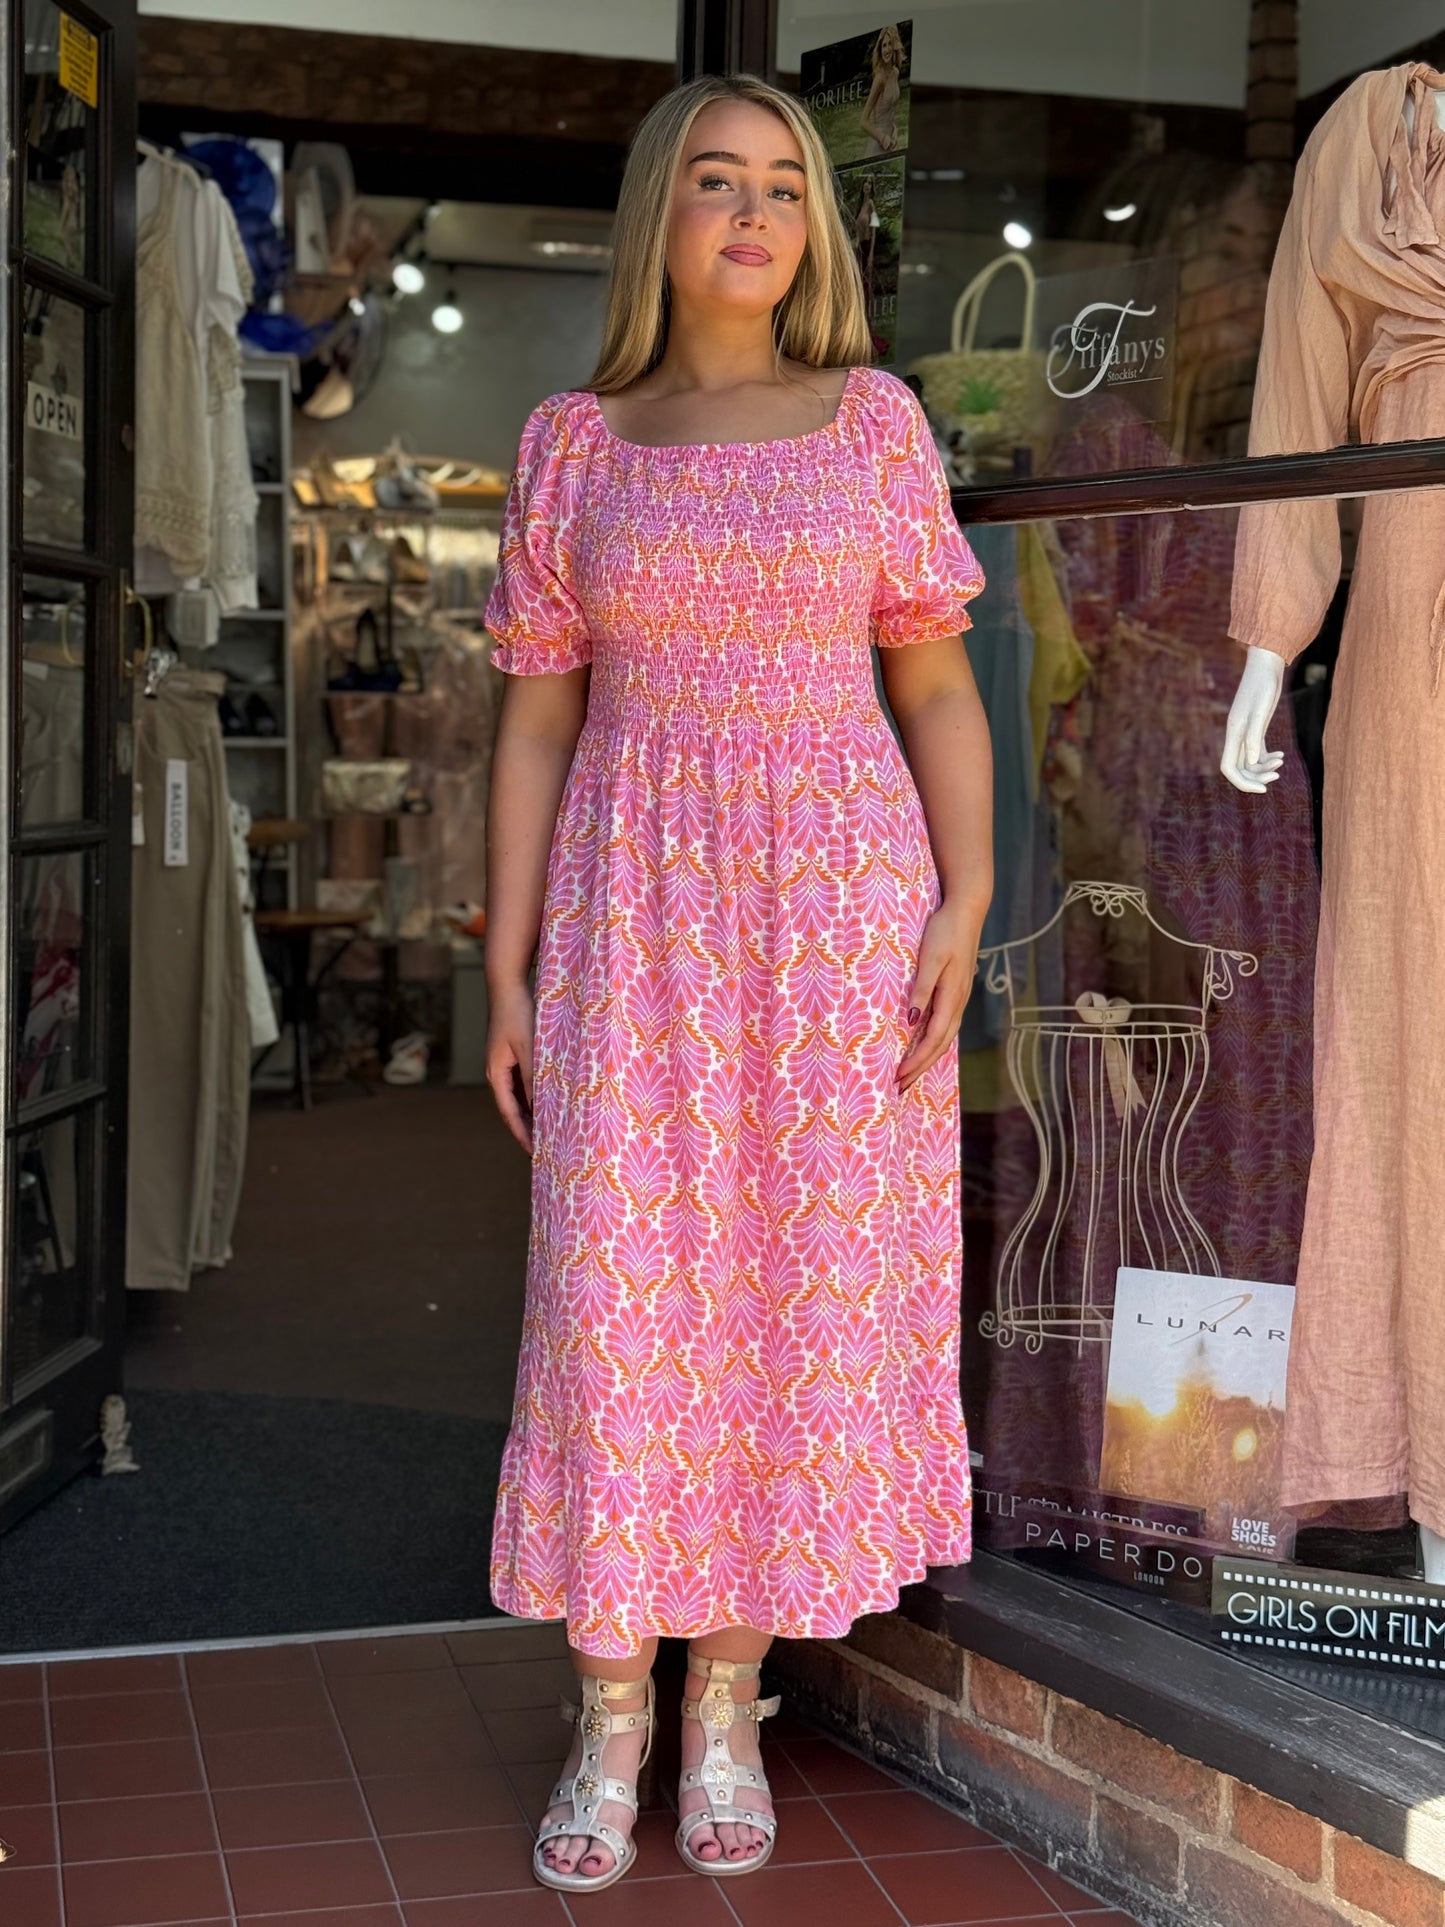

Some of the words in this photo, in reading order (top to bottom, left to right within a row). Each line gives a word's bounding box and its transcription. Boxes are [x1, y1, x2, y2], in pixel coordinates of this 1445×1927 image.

[803, 80, 863, 112] MORILEE
[1107, 368, 1137, 382] Stockist
[33, 392, 77, 437] OPEN
[1137, 1313, 1286, 1341] LUNAR
[1231, 1529, 1276, 1547] SHOES
[1232, 1517, 1269, 1534] LOVE
[1026, 1522, 1141, 1566] PAPER
[1133, 1570, 1166, 1587] LONDON
[1227, 1592, 1317, 1633] GIRLS
[1325, 1605, 1377, 1641] ON
[1386, 1611, 1445, 1649] FILM
